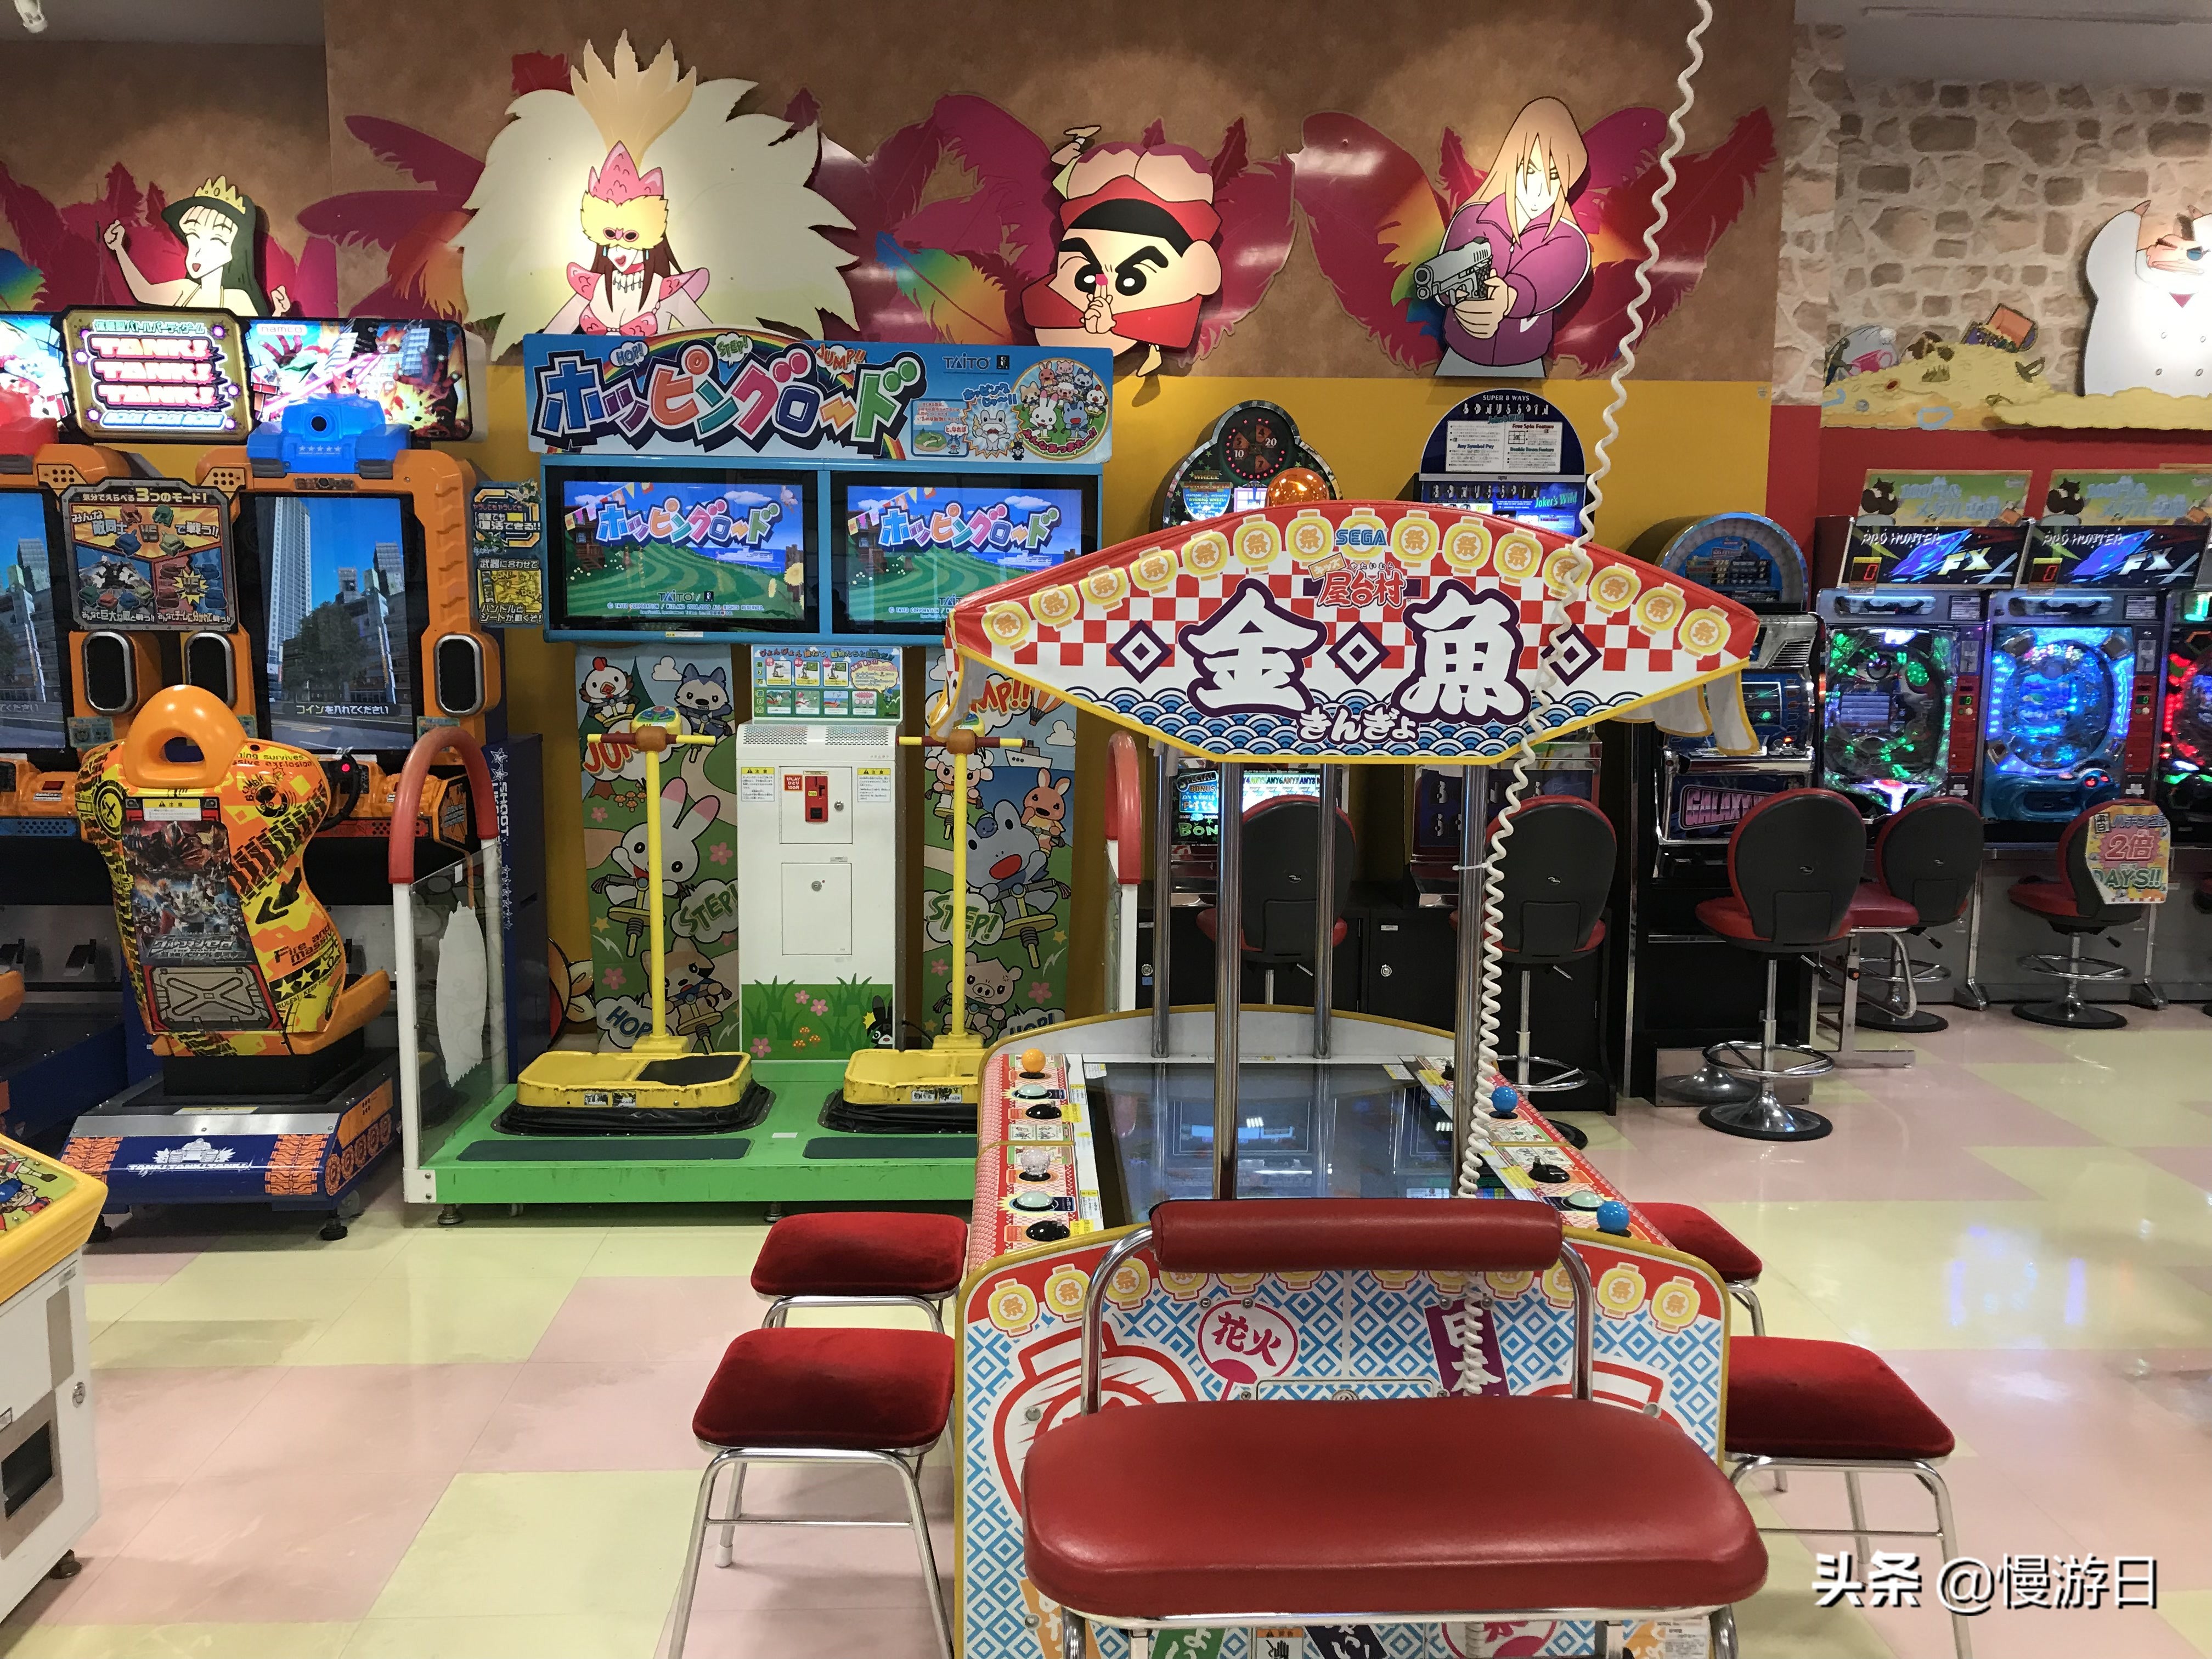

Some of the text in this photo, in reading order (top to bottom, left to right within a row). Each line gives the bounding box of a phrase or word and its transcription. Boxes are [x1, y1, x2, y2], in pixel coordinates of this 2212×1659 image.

[261, 325, 302, 334] namco
[90, 337, 213, 360] TANK!
[616, 345, 644, 365] HOP!
[716, 335, 748, 357] STEP!
[815, 345, 866, 373] JUMP!!
[943, 353, 990, 370] TAITO
[94, 360, 216, 384] TANK!
[98, 384, 219, 408] TANK!
[540, 345, 924, 443] ホッピングロード
[1265, 438, 1277, 446] 20
[1234, 450, 1244, 458] 10
[1535, 495, 1558, 508] Joker's
[596, 496, 782, 547] ホッピングロード
[877, 496, 1063, 549] ホッピングロード
[1246, 533, 1267, 555] 祭
[1299, 528, 1320, 550] 祭
[1335, 528, 1387, 546] SEGA
[1404, 530, 1425, 551] 祭
[1457, 536, 1478, 557] 祭
[1890, 531, 1943, 545] HUNTER
[2071, 532, 2124, 546] HUNTER
[480, 559, 539, 569] 武器に合わせて
[1195, 543, 1216, 564] 祭
[1508, 545, 1528, 565] 祭
[1143, 558, 1164, 577] 祭
[1093, 573, 1115, 594] 祭
[1318, 569, 1407, 608] 屋台村
[1601, 578, 1623, 596] 祭
[658, 589, 695, 602] TAITO
[938, 594, 962, 606] TAIT
[1048, 593, 1068, 614] 祭
[1647, 597, 1671, 619] 祭
[995, 613, 1018, 635] 祭
[1694, 621, 1716, 644] 祭
[296, 705, 388, 714] コインを入れてください
[1298, 707, 1420, 744] きんぎょ
[1299, 776, 1316, 785] ANY8
[499, 781, 509, 837] SHOOT
[2104, 833, 2154, 861] 2倍
[274, 942, 307, 963] Fire
[1116, 1271, 1134, 1290] 祭
[1612, 1281, 1631, 1300] 祭
[1059, 1282, 1080, 1302] 祭
[1003, 1296, 1024, 1317] 祭
[1666, 1294, 1686, 1313] 祭
[1211, 1312, 1282, 1367] 花火
